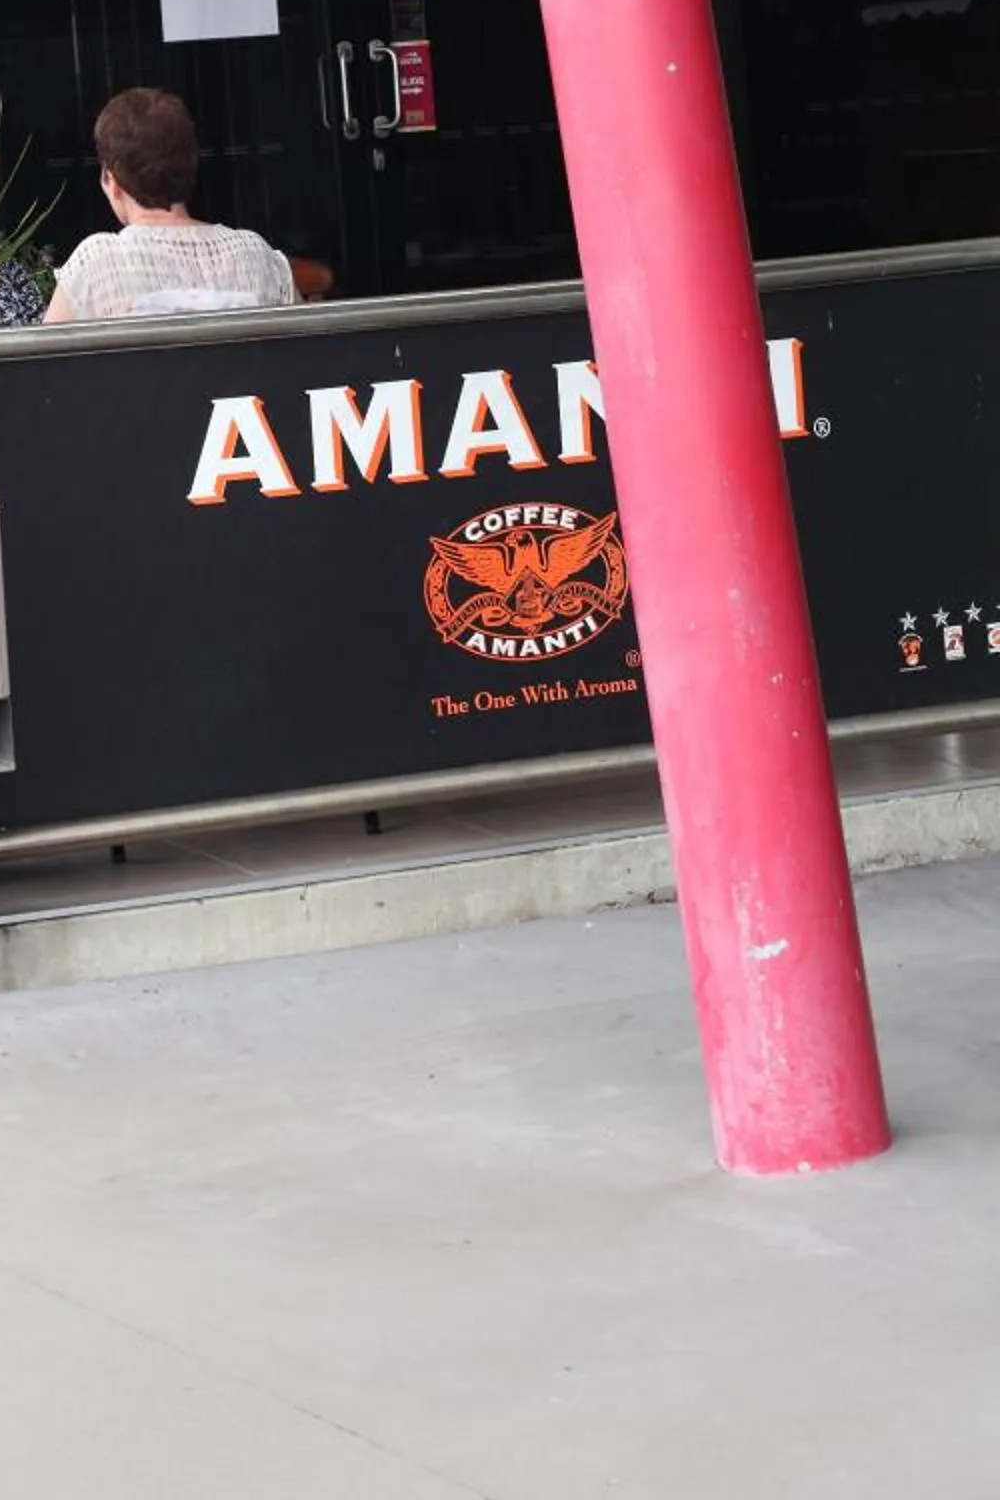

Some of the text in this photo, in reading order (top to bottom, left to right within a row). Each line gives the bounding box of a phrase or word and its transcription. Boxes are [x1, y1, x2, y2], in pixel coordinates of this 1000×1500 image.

[187, 338, 811, 504] AMAI
[464, 506, 578, 542] COFFEE
[465, 615, 598, 657] AMANTI
[431, 678, 639, 718] The One With Aroma
